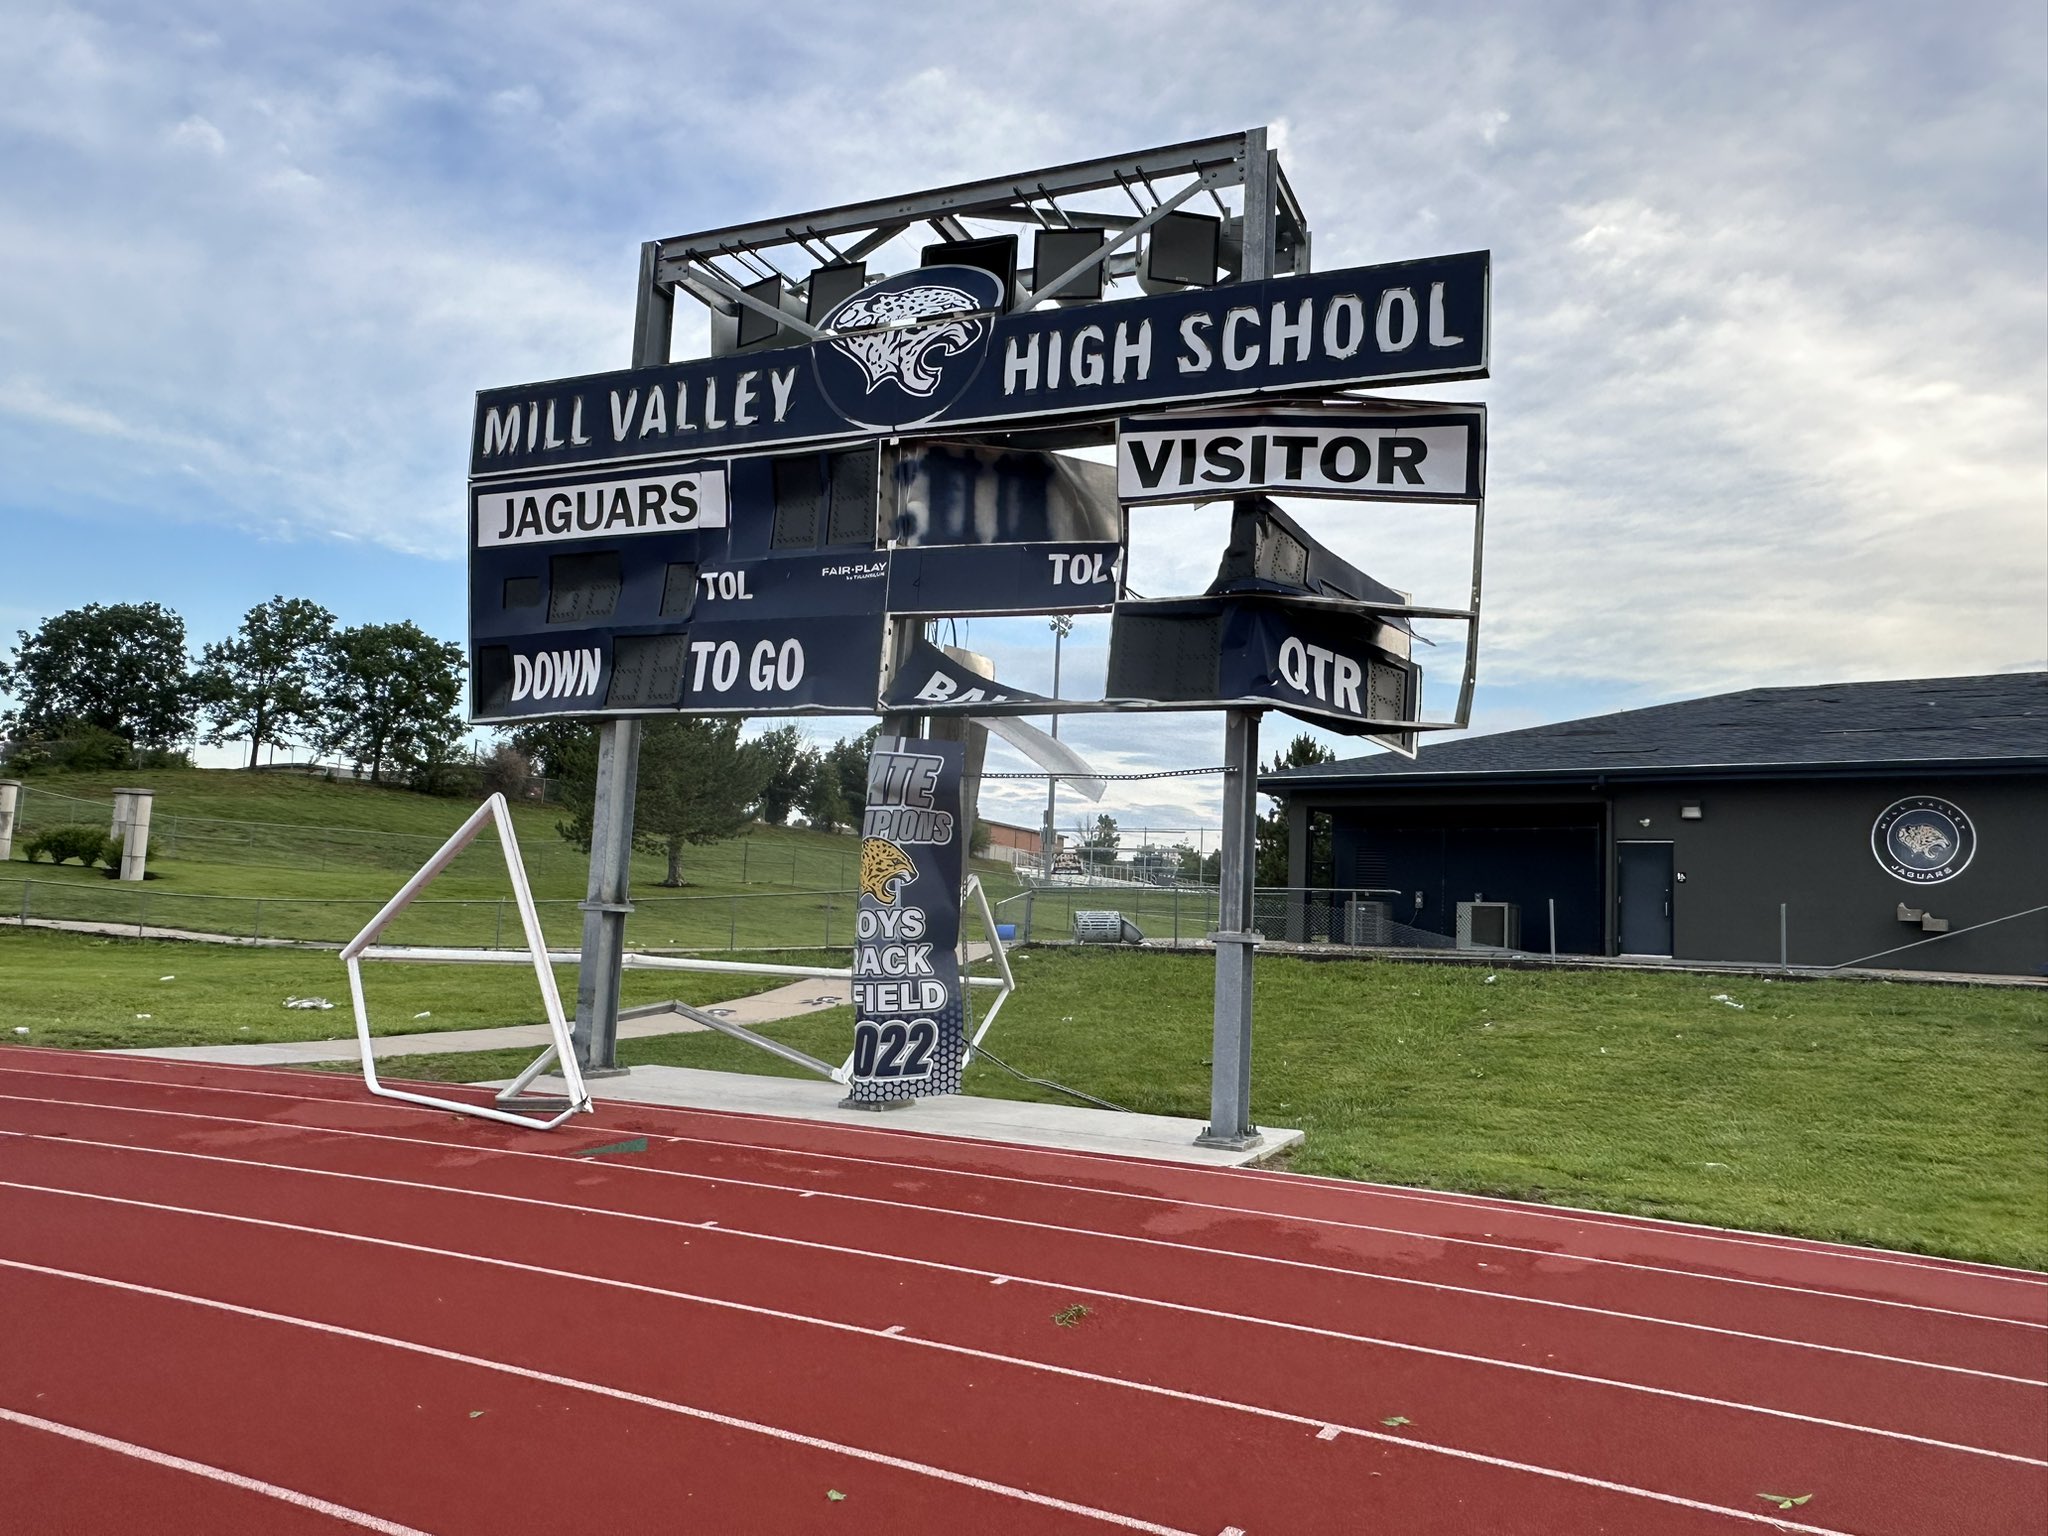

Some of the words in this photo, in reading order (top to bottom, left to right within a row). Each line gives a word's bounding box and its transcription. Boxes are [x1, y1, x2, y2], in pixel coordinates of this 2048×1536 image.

[483, 395, 592, 457] MILL
[611, 367, 797, 441] VALLEY
[1004, 318, 1153, 395] HIGH
[1178, 282, 1464, 373] SCHOOL
[1127, 434, 1429, 489] VISITOR
[498, 480, 699, 540] JAGUARS
[700, 570, 754, 601] TOL
[1048, 554, 1111, 585] TOL
[511, 648, 601, 701] DOWN
[691, 640, 740, 692] TO
[750, 638, 805, 692] GO
[1278, 636, 1362, 715] QTR
[1918, 801, 1966, 829] VALLEY
[1891, 864, 1953, 880] JAGUARS
[854, 943, 934, 977] ACK
